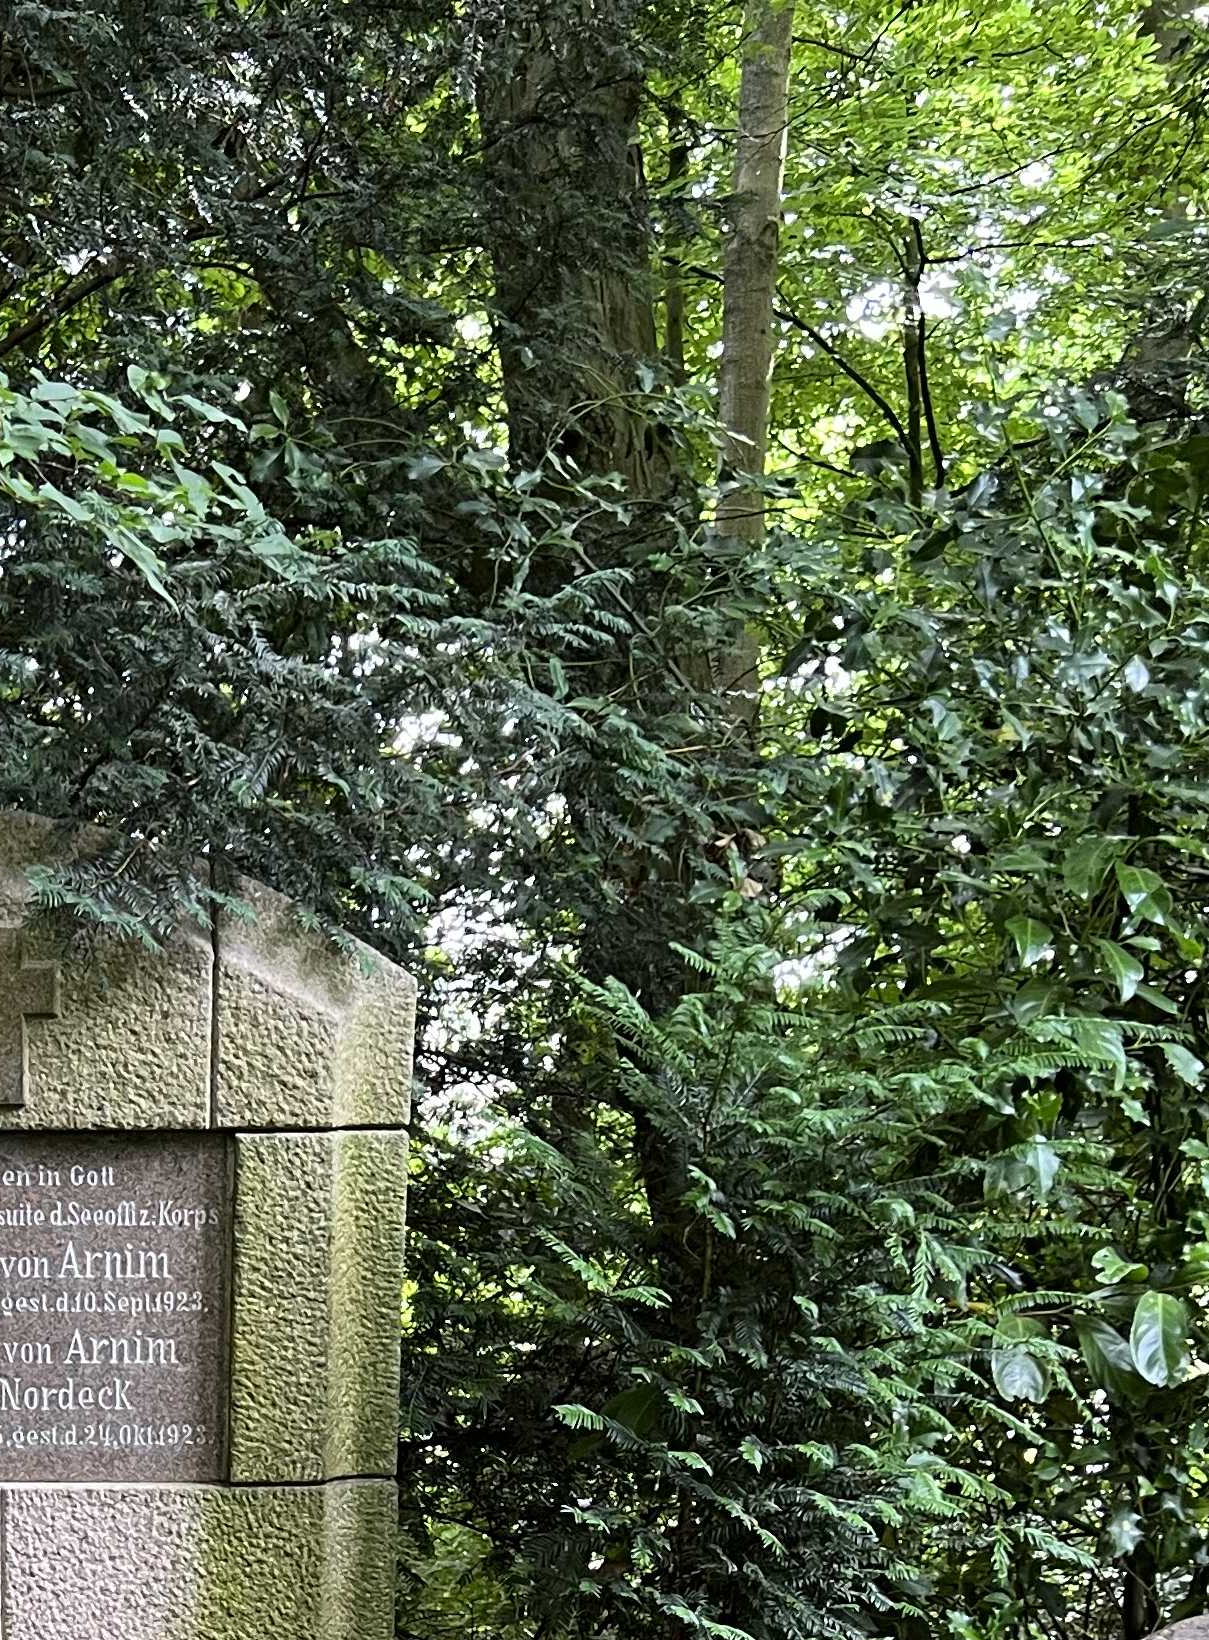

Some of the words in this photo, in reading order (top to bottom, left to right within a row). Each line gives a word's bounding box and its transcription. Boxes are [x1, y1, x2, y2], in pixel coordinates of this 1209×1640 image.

[38, 1165, 61, 1187] in
[70, 1164, 116, 1187] Gott
[57, 1239, 173, 1280] Arnim
[2, 1341, 54, 1364] von
[62, 1327, 180, 1364] Arnim
